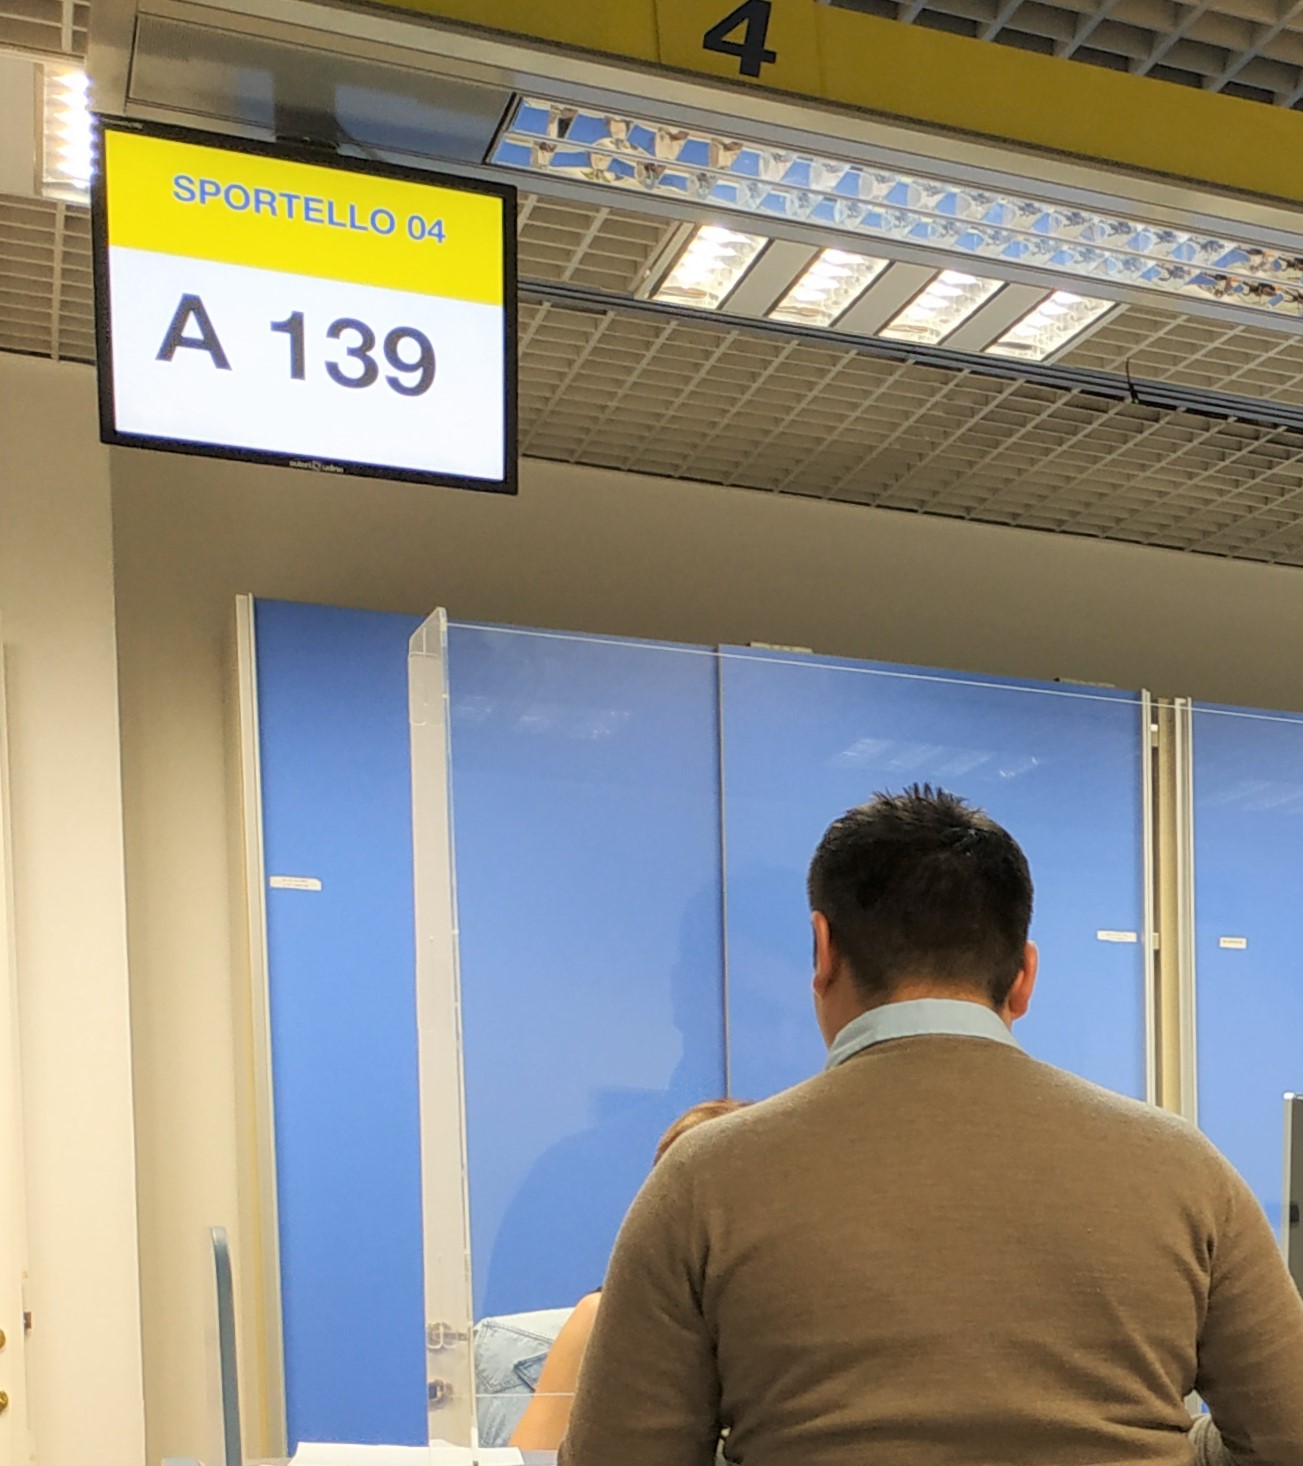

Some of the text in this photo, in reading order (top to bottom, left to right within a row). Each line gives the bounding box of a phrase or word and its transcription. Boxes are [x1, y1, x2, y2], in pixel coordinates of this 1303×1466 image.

[702, 0, 777, 78] 4
[173, 174, 446, 243] SPORTELLO 04
[155, 292, 437, 397] A 139
